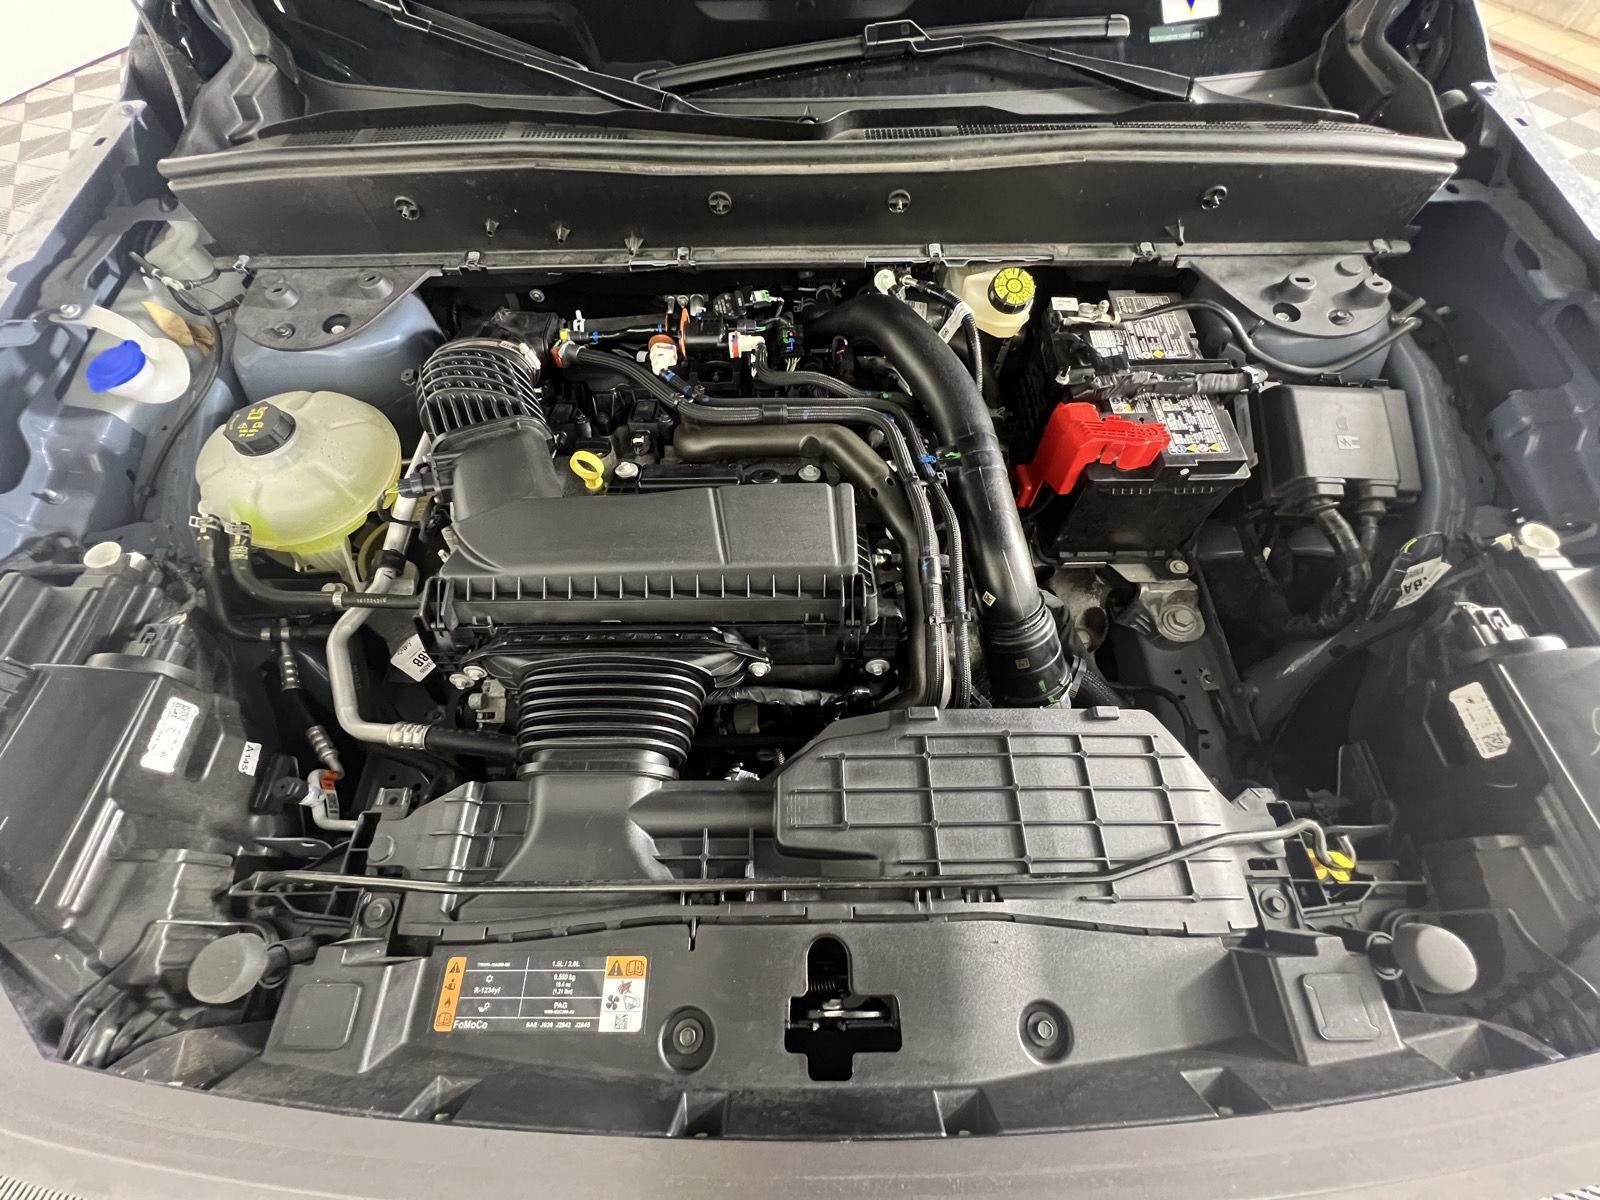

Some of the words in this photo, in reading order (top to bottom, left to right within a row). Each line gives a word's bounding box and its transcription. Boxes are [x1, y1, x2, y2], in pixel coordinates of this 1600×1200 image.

[474, 986, 501, 995] R-1234yf
[554, 1001, 568, 1009] PAG
[453, 1020, 488, 1029] FoMoCo
